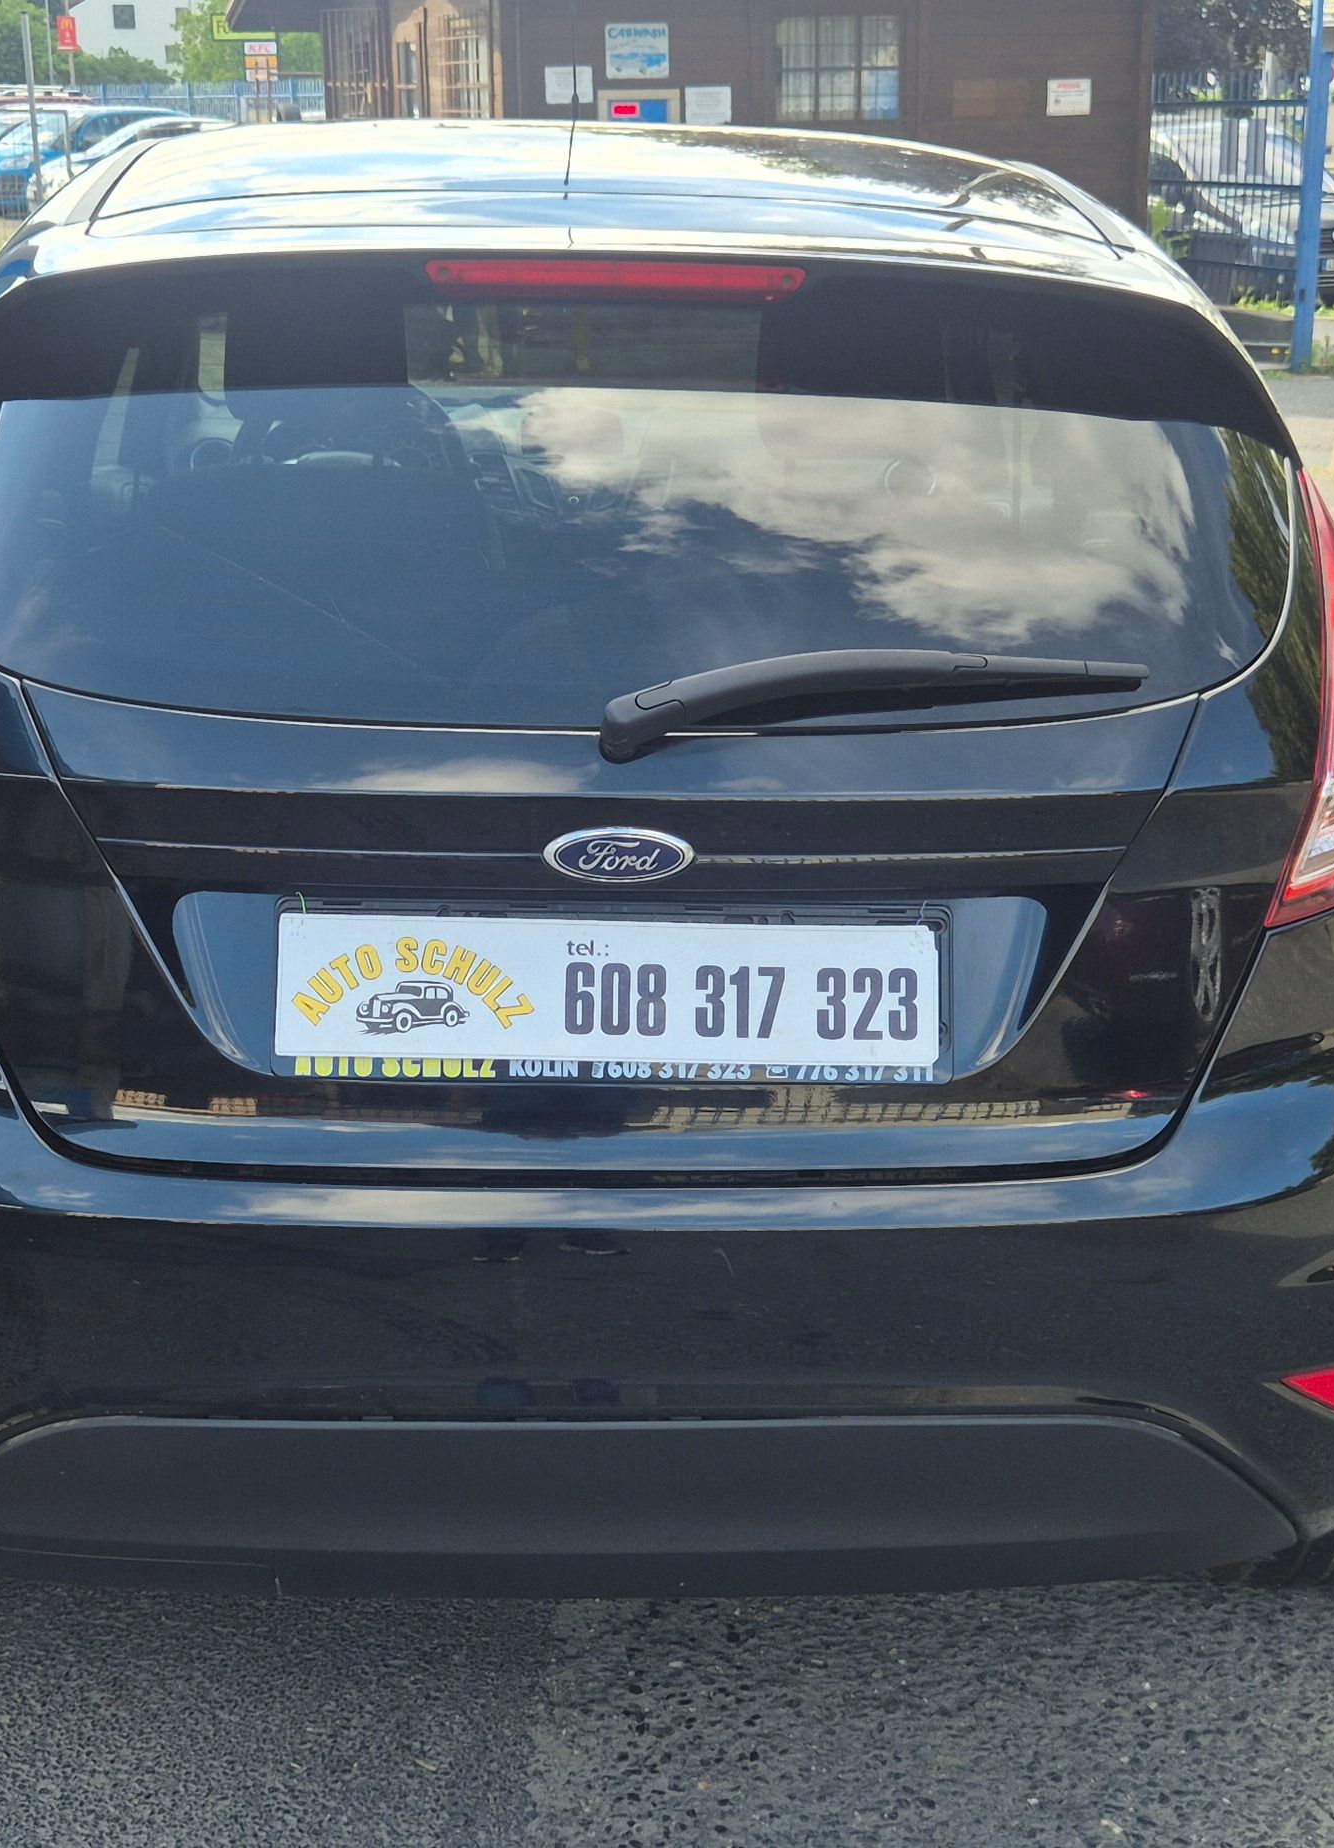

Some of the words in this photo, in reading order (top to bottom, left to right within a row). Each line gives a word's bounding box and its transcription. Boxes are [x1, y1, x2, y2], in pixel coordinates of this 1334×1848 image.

[578, 840, 661, 871] Ford
[566, 939, 610, 957] tel.:
[291, 944, 383, 1026] AUTO
[395, 936, 536, 1029] SCHULZ
[564, 961, 667, 1037] 608
[695, 964, 786, 1039] 317
[817, 967, 918, 1041] 323
